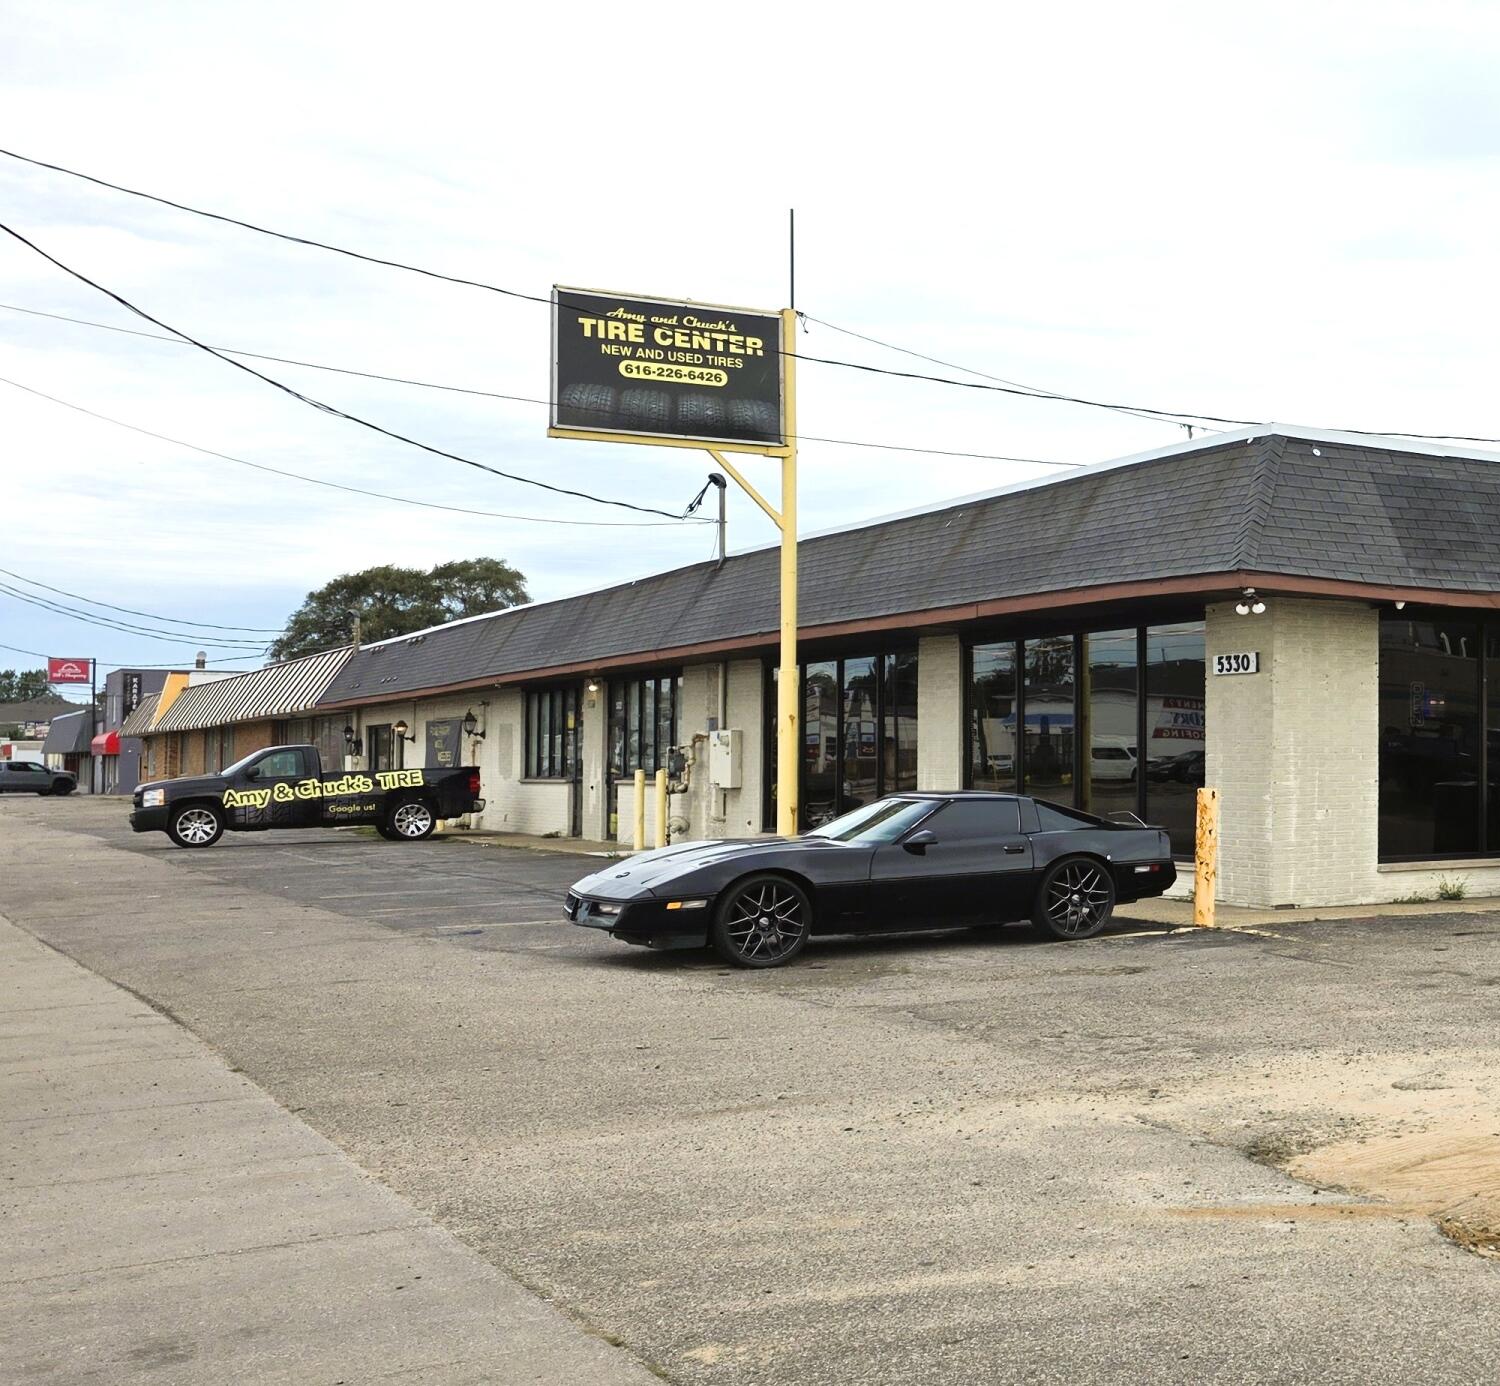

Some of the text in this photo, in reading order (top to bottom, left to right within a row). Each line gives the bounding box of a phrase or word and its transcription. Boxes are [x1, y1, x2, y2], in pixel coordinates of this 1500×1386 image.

[606, 307, 738, 333] Amy and Chuck's
[578, 317, 764, 356] TIRE CENTER
[601, 343, 744, 369] NEW AND USED TIRES
[624, 363, 723, 383] 616-226-6426
[1217, 654, 1250, 673] 5330
[224, 769, 424, 808] Amy & Chuck's TIRE
[328, 803, 376, 813] Google us!
